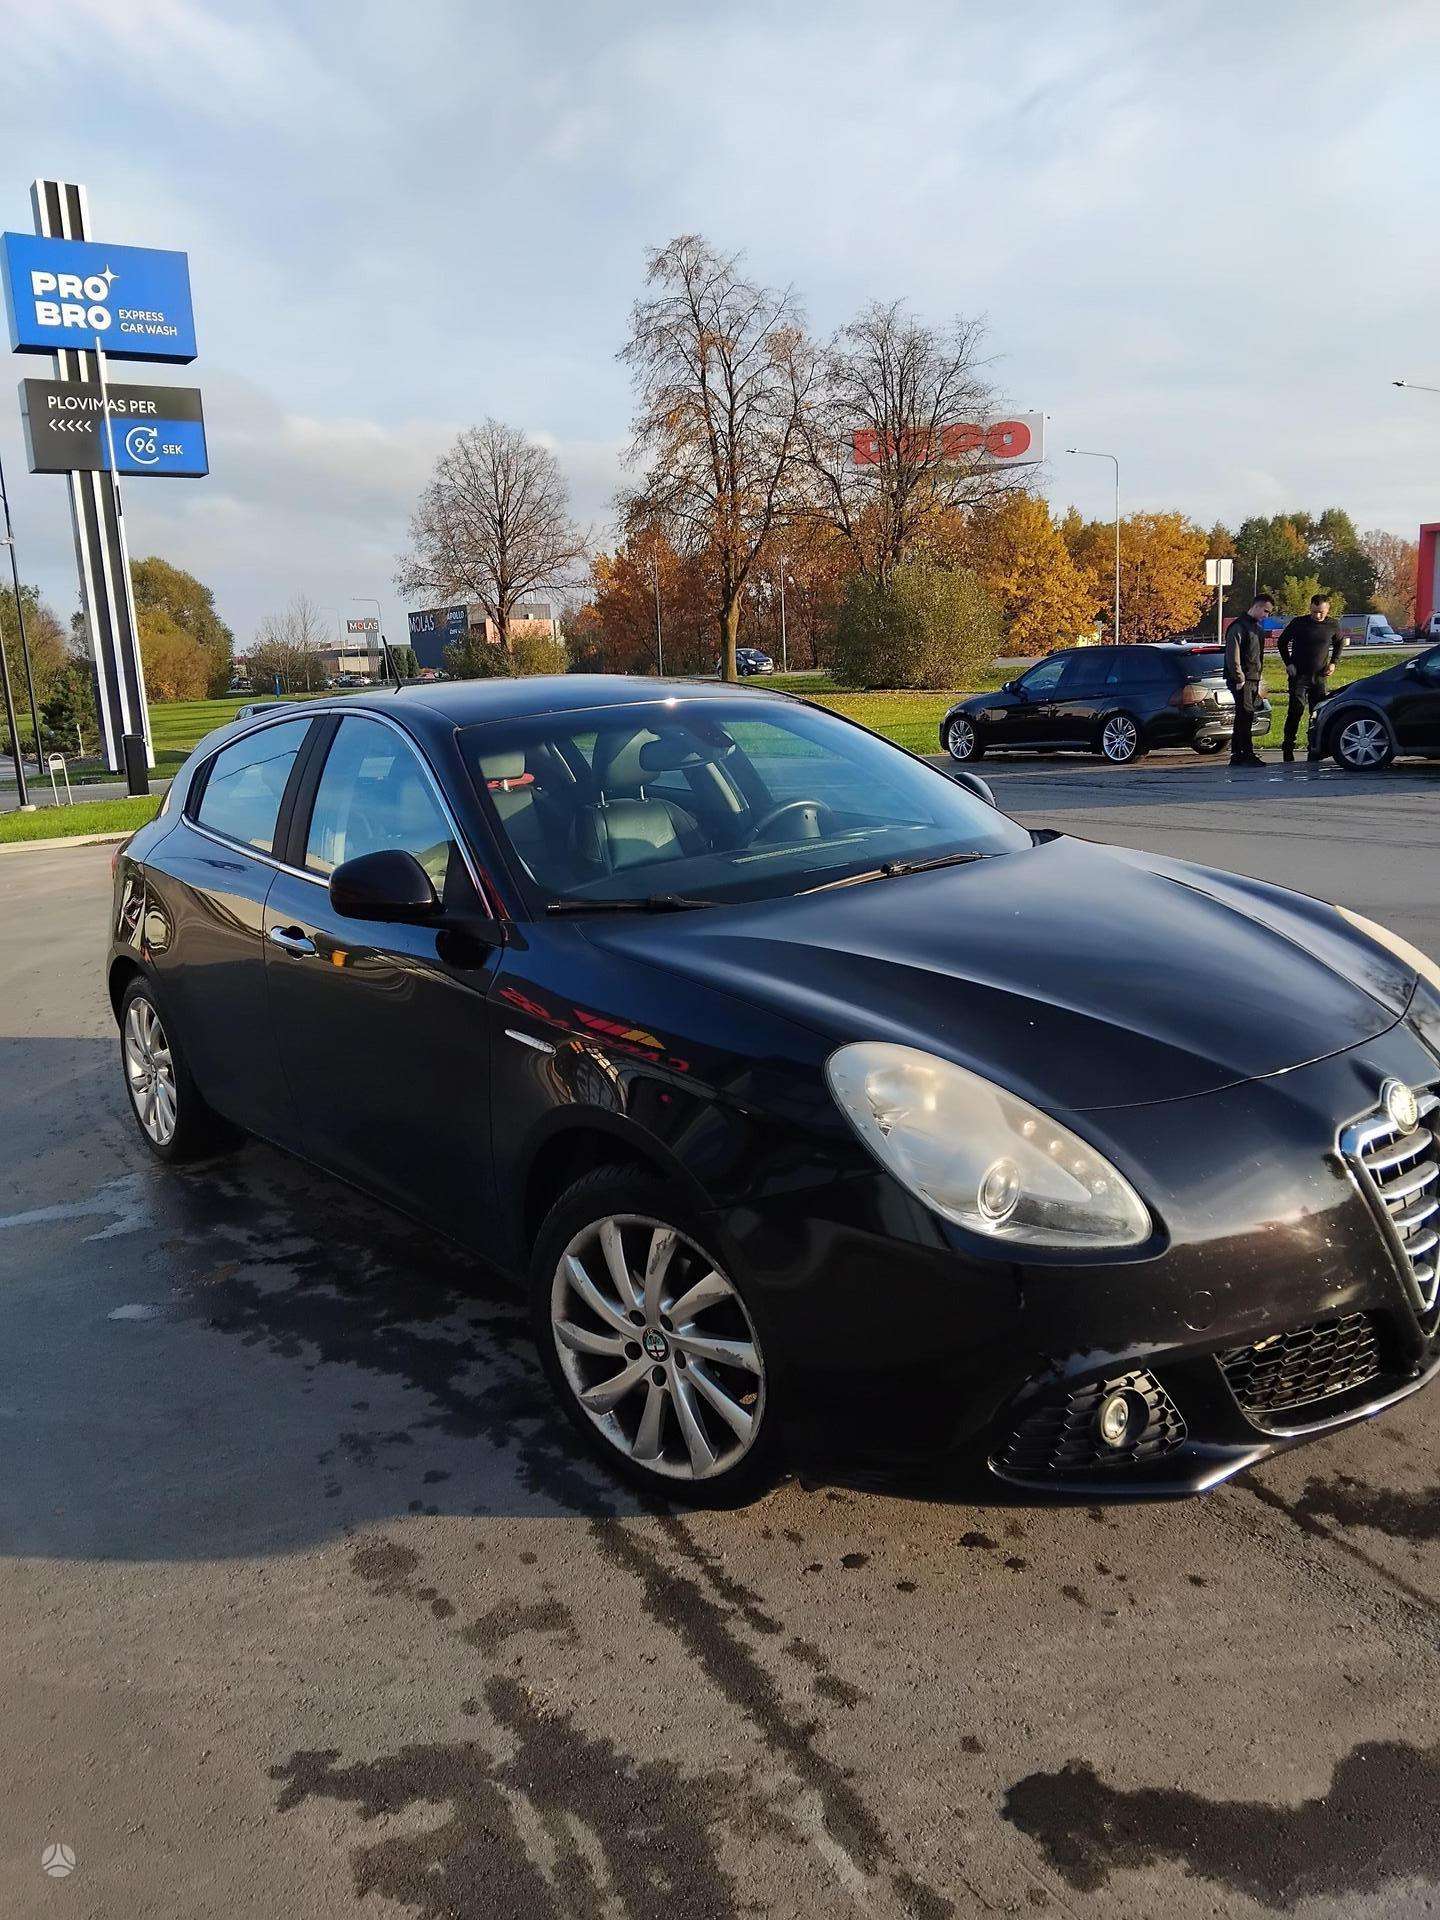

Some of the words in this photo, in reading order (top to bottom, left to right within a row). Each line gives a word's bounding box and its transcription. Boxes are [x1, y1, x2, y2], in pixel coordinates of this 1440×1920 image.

[31, 270, 109, 301] PRO
[34, 300, 111, 330] BRO
[118, 309, 164, 321] EXPRESS
[120, 322, 145, 334] CAR
[145, 325, 178, 336] WASH
[47, 395, 126, 413] PLOVIMAS
[129, 400, 158, 414] PER
[134, 437, 156, 454] 96
[162, 444, 184, 455] SEK
[349, 622, 378, 630] MOLAS
[409, 615, 435, 633] MOLAS
